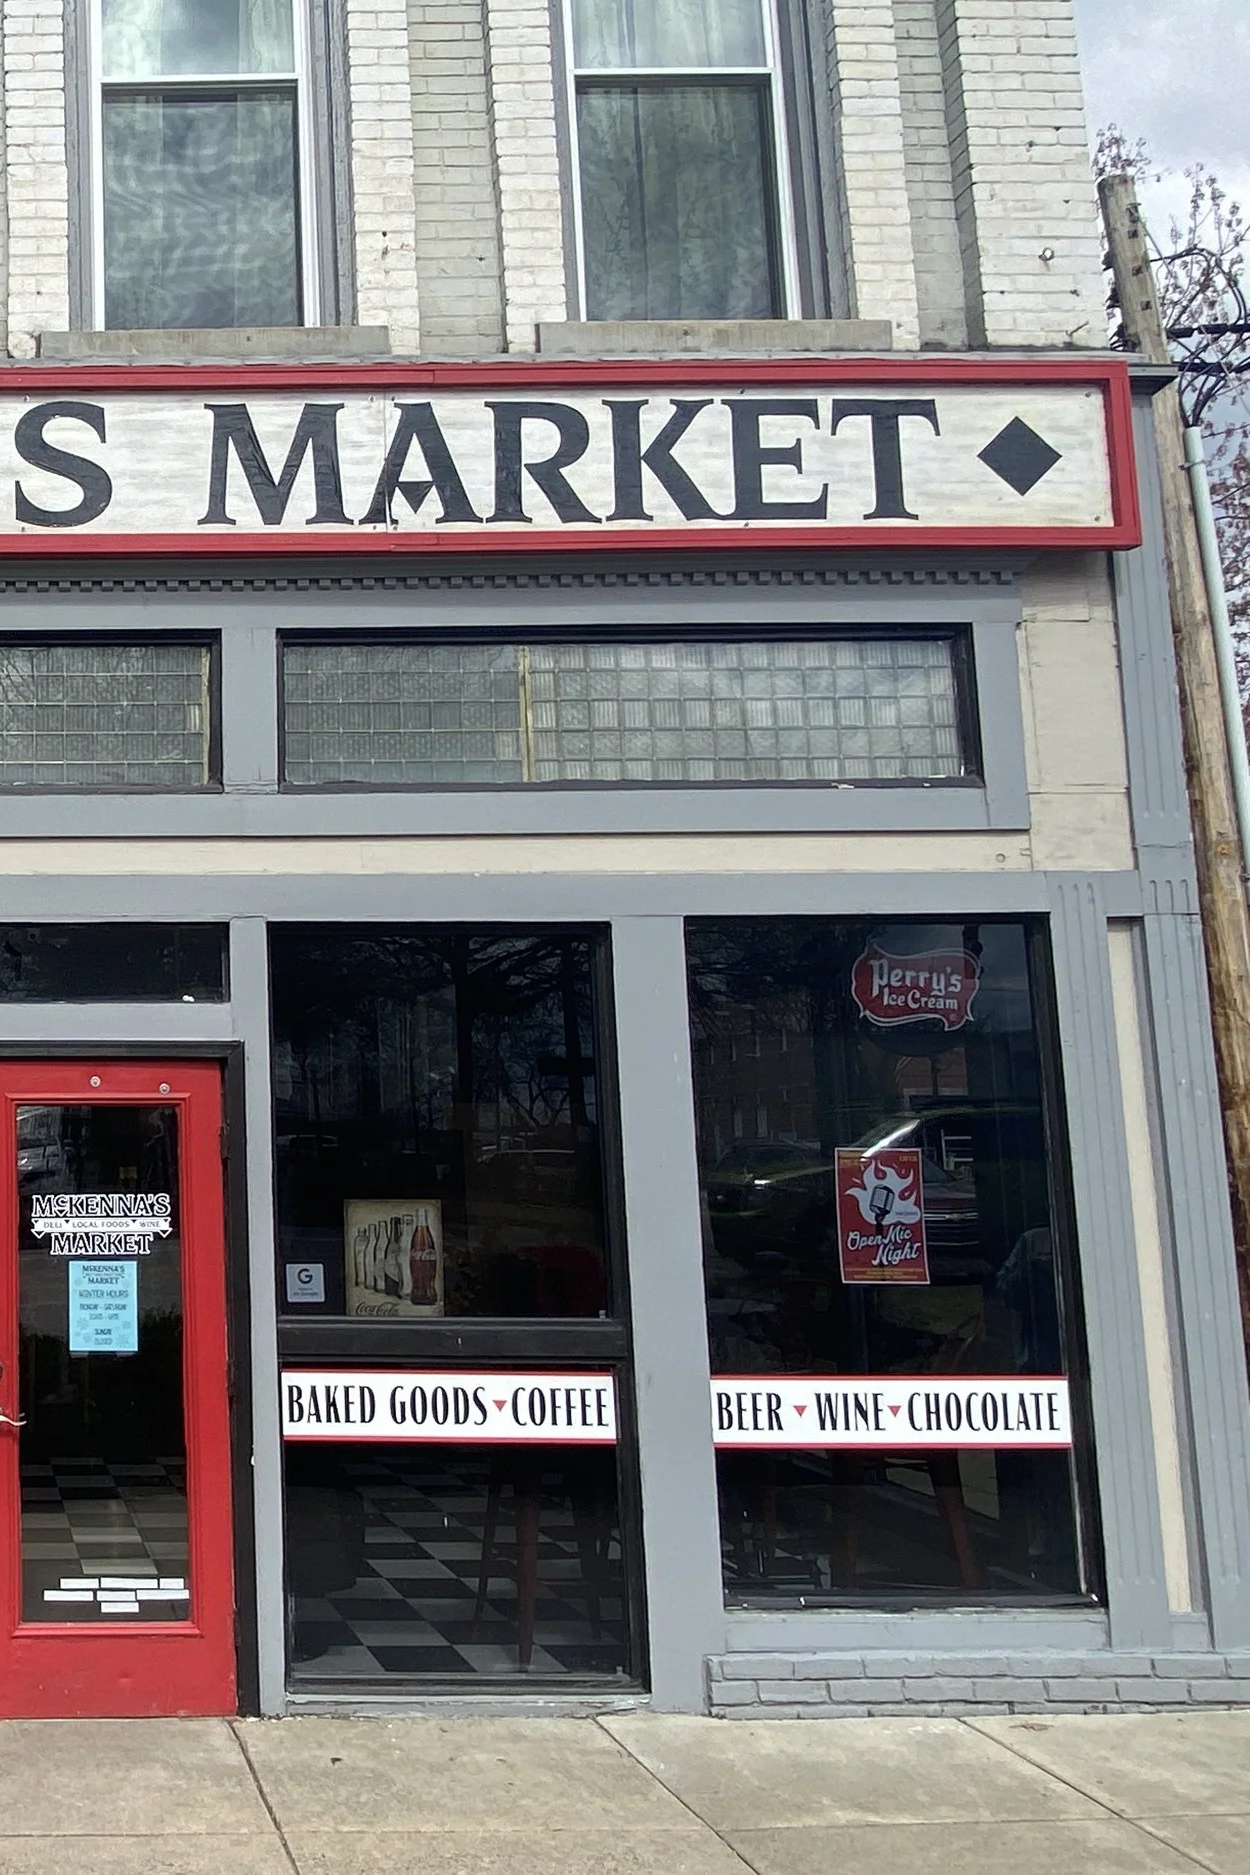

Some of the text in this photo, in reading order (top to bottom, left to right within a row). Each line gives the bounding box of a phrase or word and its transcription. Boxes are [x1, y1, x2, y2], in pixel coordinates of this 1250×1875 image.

[197, 399, 941, 526] MARKET
[867, 958, 962, 998] Perry's
[883, 987, 958, 1010] Ice Cream
[101, 1220, 130, 1228] FOODS
[50, 1232, 154, 1255] MARKET
[847, 1224, 913, 1250] Open Mic
[872, 1242, 921, 1266] Night
[88, 1277, 120, 1285] MARKET
[78, 1289, 129, 1299] WINTER HOURS
[287, 1385, 609, 1427] BAKED GOODS COFFEE
[716, 1392, 1061, 1432] BEER WINE CHOCOLATE
